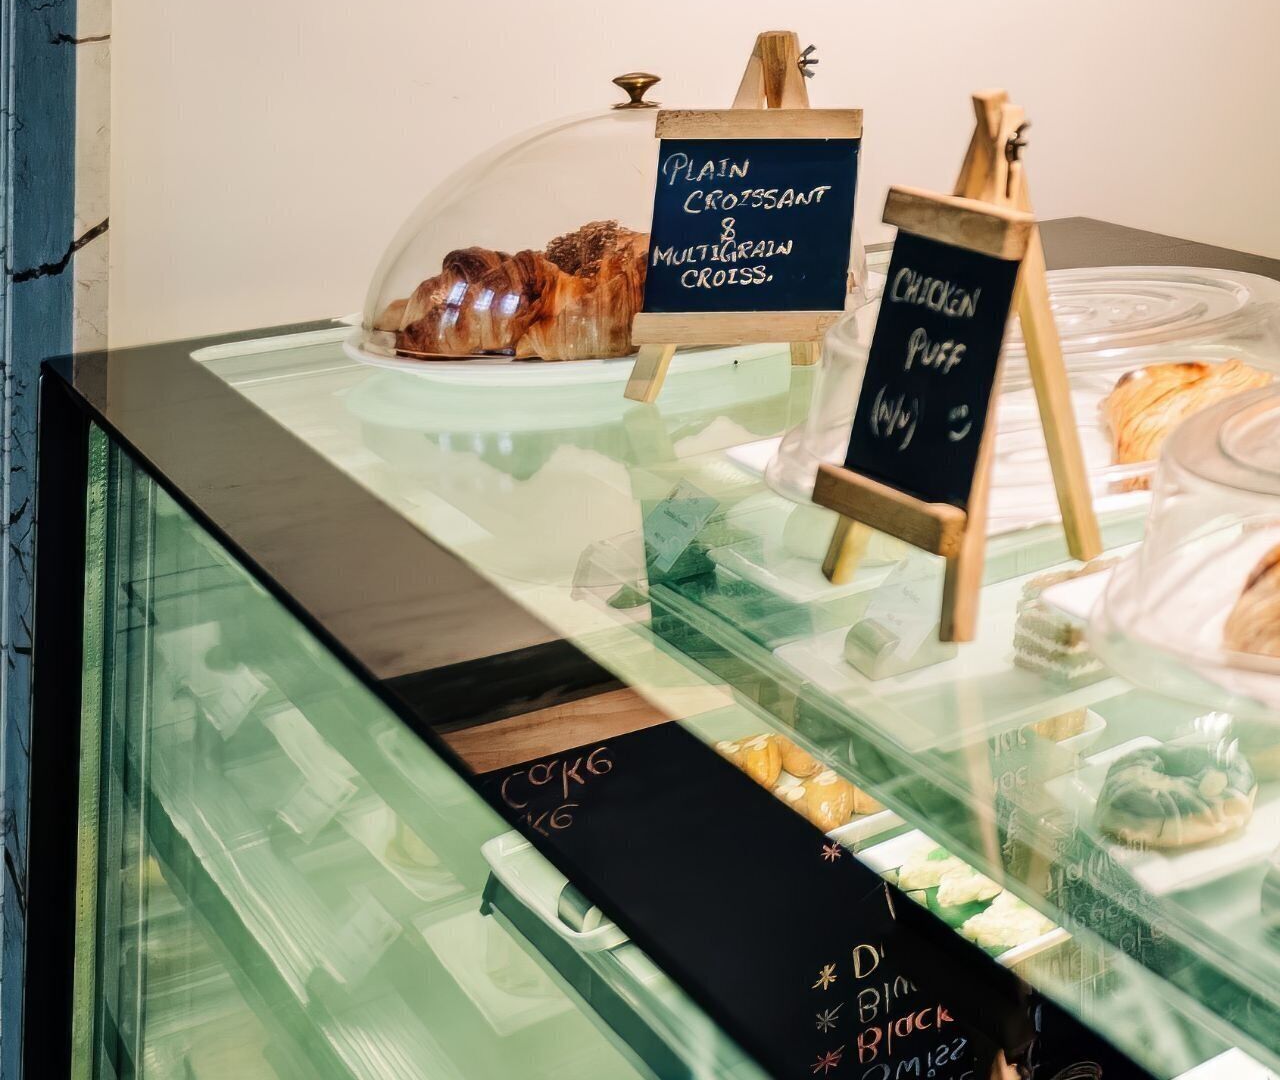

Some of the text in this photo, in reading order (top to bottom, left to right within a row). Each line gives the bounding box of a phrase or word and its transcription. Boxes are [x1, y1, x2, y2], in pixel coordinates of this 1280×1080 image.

[663, 153, 749, 185] PLAIN
[684, 186, 831, 214] CROISSANT
[653, 240, 793, 266] MULTIGRAIN
[891, 268, 982, 317] CHICKEN
